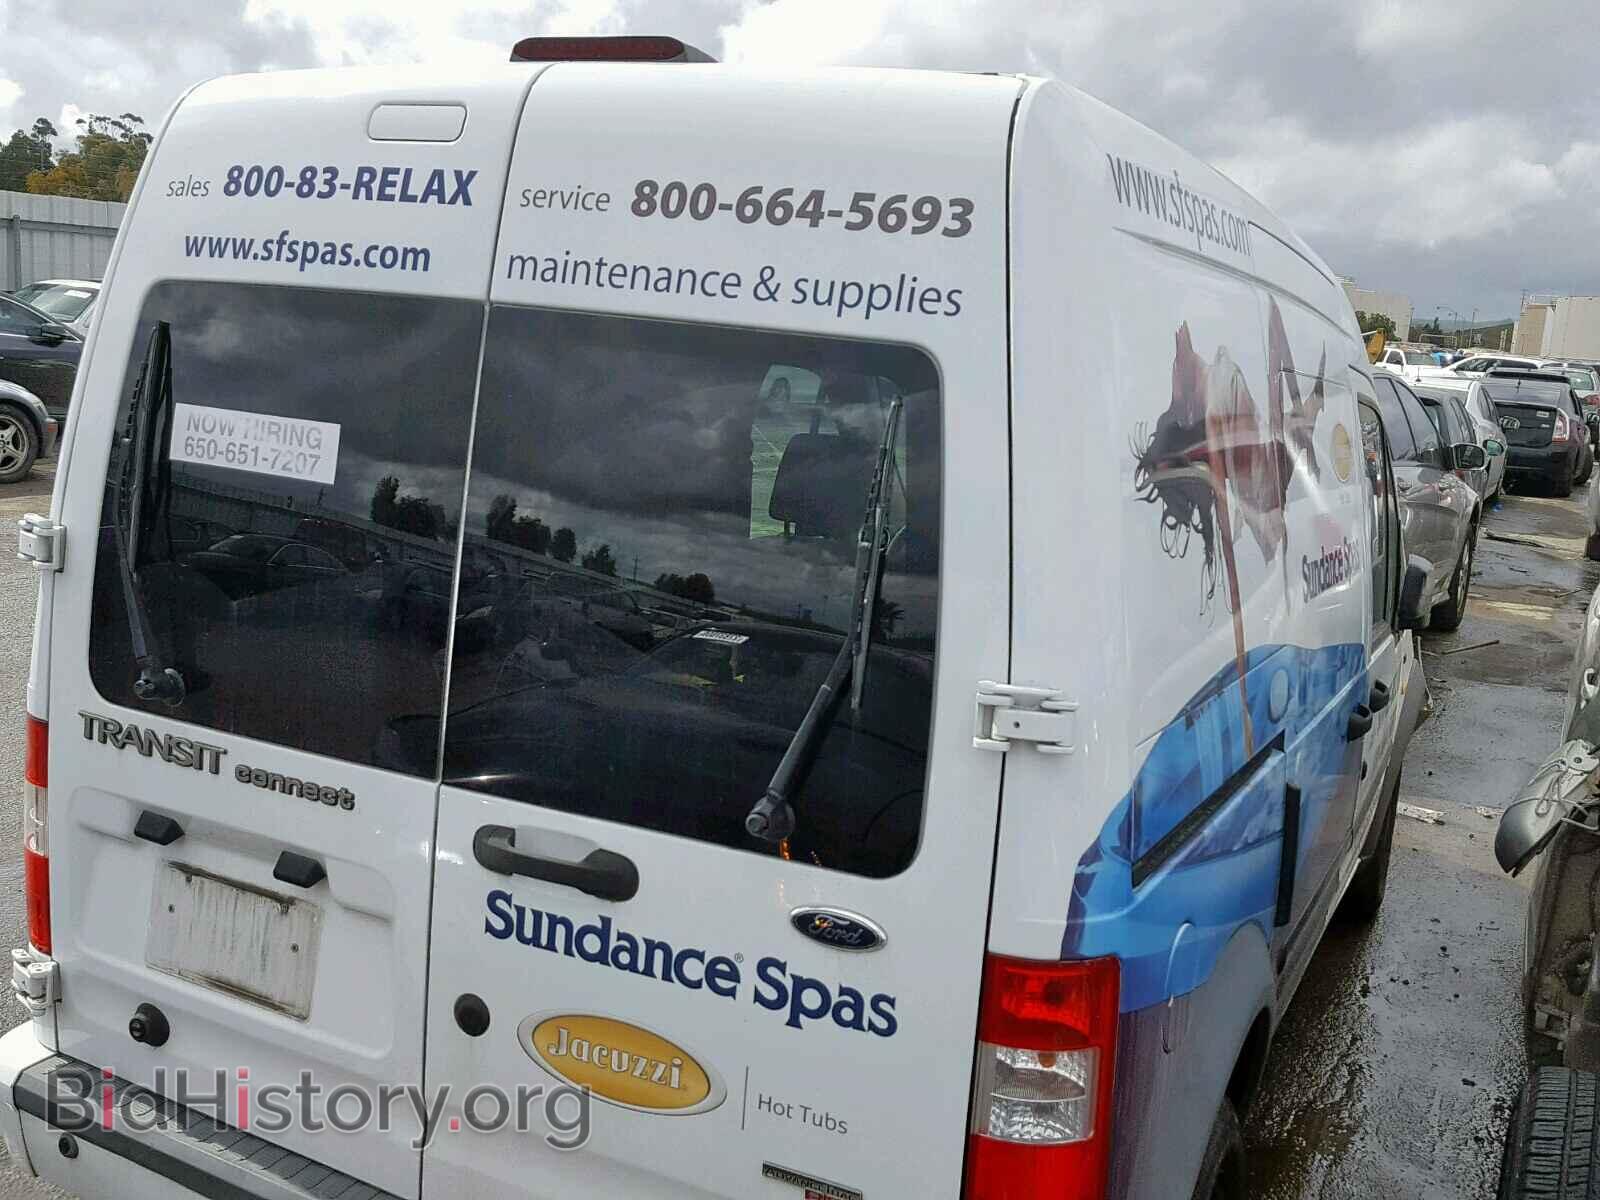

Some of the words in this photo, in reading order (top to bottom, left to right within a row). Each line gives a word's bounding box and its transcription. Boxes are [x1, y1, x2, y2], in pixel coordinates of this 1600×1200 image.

[166, 175, 210, 198] sales
[223, 164, 478, 207] 800-83-RELAX
[519, 184, 611, 212] service
[631, 178, 976, 238] 800-664-5693
[184, 230, 432, 273] www.sfspas.com
[506, 250, 742, 299] maintenance
[753, 265, 781, 302] &
[791, 273, 963, 320] supplies
[186, 411, 235, 437] NOW
[184, 435, 322, 476] 650-651-7207
[78, 710, 228, 775] TRANSIT
[234, 763, 356, 811] connect
[808, 914, 864, 944] Ford
[484, 888, 742, 1000] Sundance
[752, 956, 899, 1038] Spas
[548, 1026, 684, 1091] Jacuzzi
[757, 1092, 794, 1120] Hot
[800, 1104, 849, 1135] Tubs
